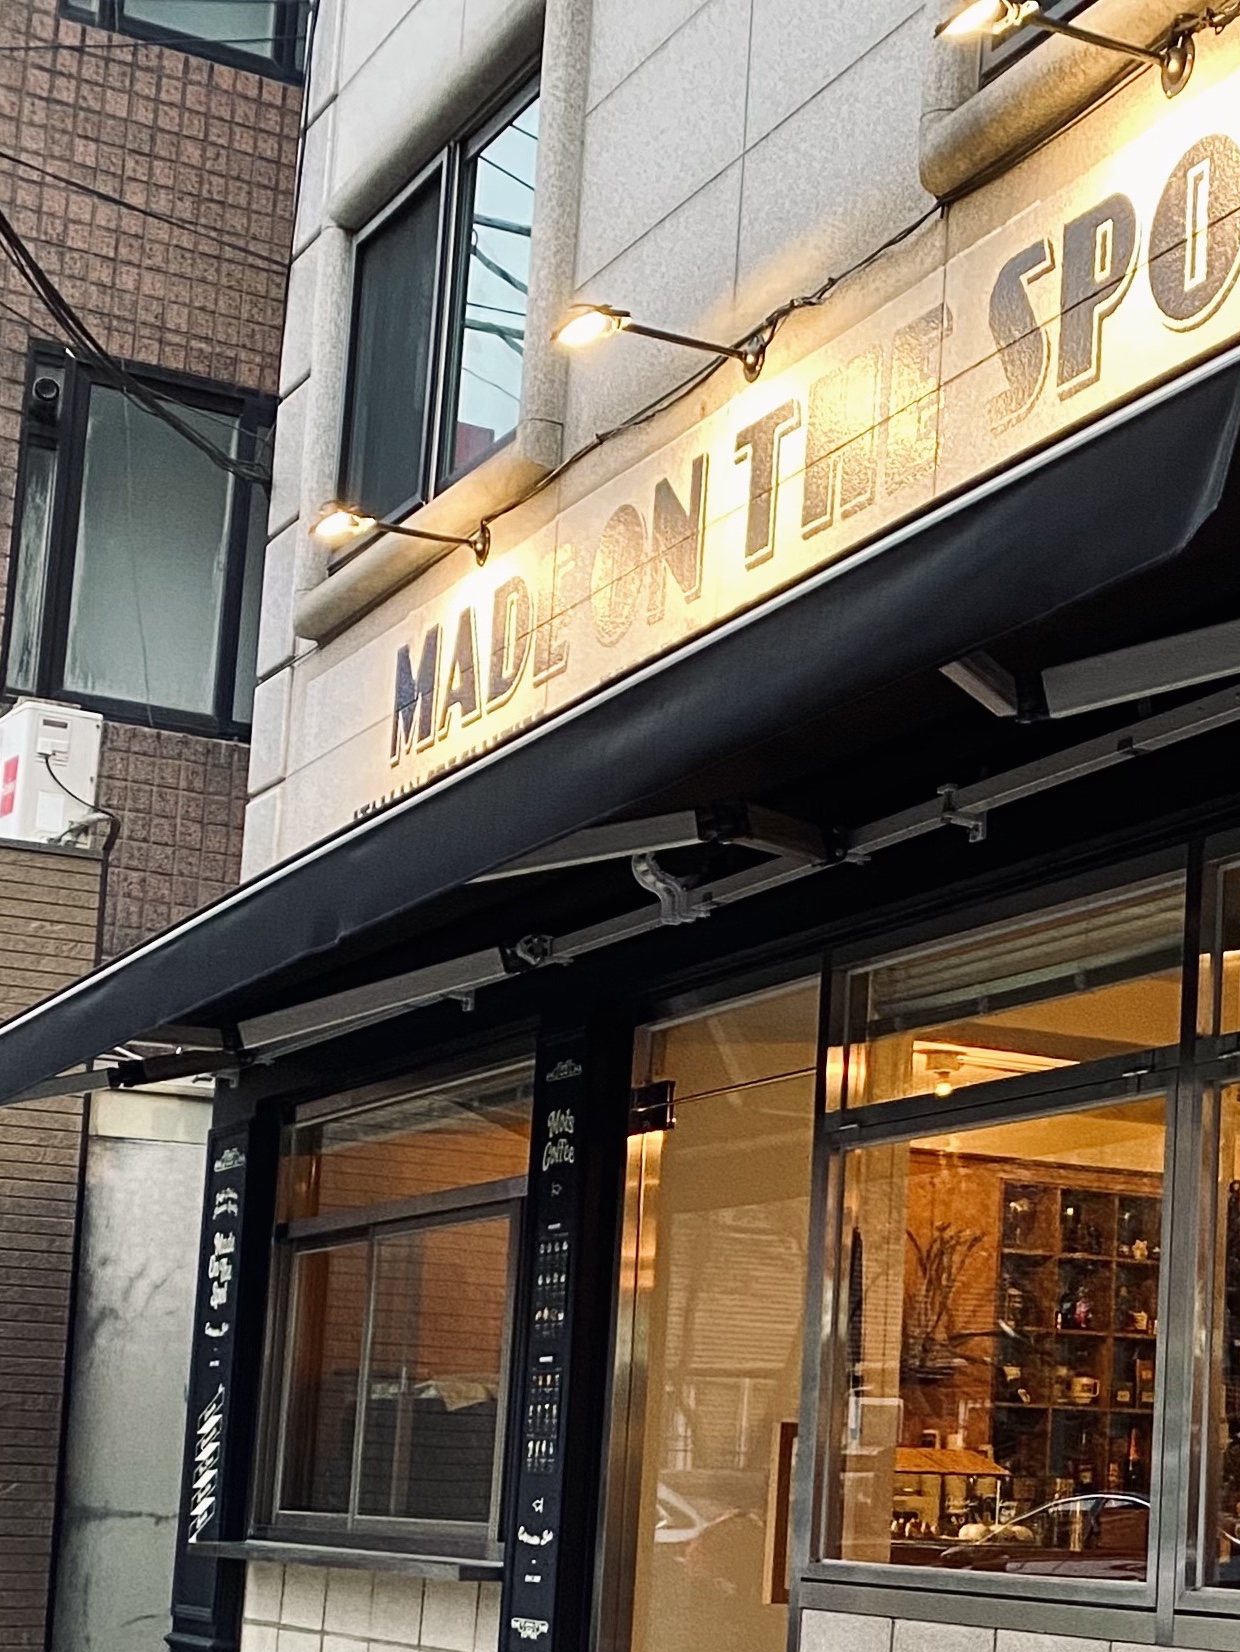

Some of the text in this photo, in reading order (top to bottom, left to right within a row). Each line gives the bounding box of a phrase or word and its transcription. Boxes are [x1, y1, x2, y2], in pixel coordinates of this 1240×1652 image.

[391, 543, 570, 768] MADE
[591, 452, 709, 647] ON
[734, 302, 952, 572] THE
